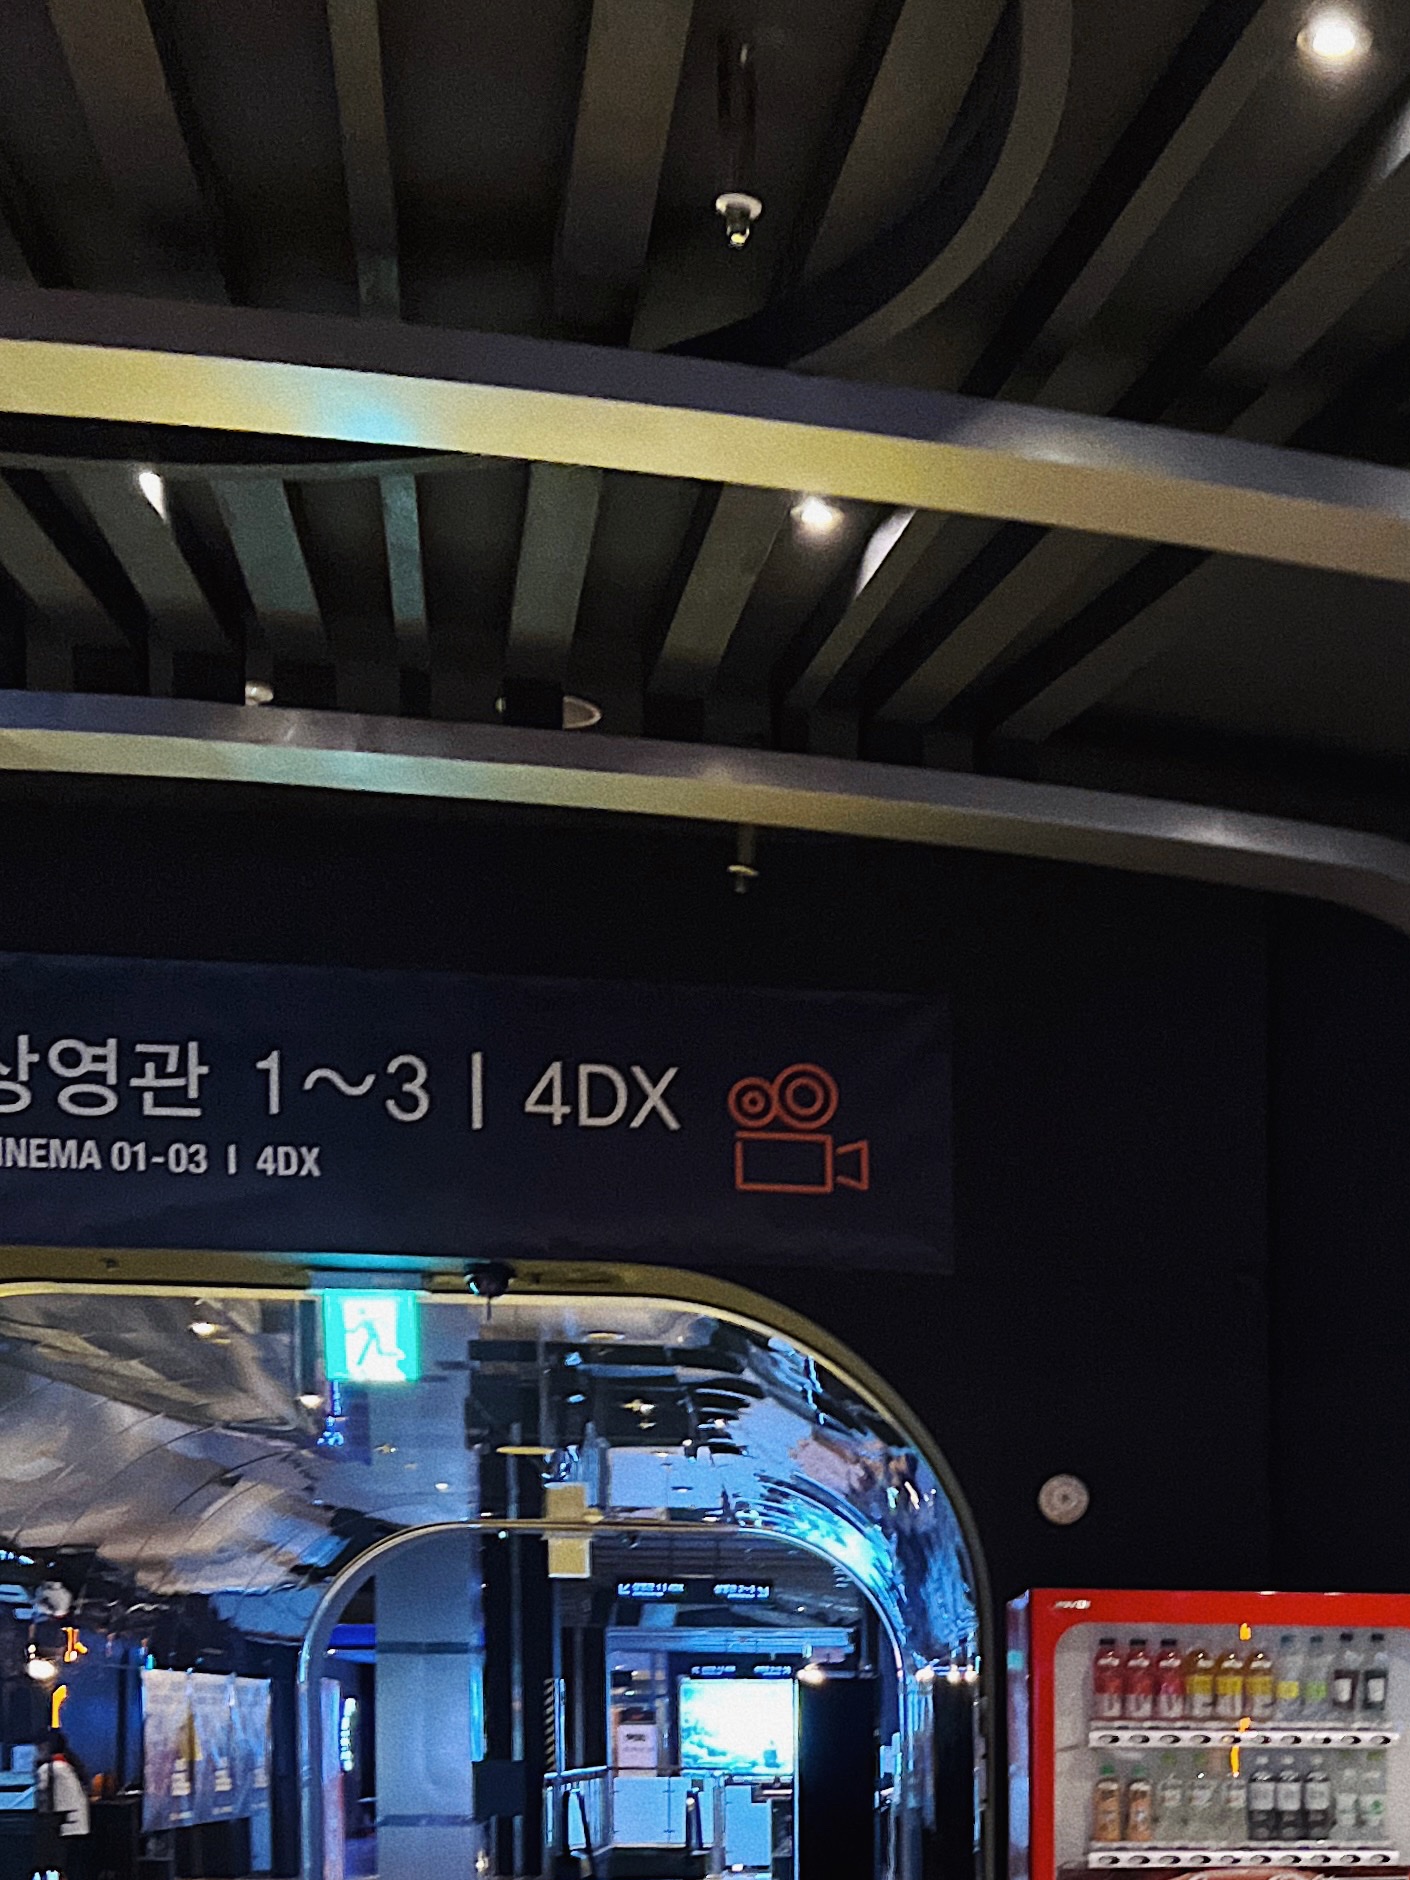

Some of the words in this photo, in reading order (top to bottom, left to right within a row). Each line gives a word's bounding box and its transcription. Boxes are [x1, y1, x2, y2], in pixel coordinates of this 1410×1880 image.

[524, 1061, 682, 1130] 4DX
[111, 1141, 209, 1174] 01-03
[256, 1145, 321, 1177] 4DX
